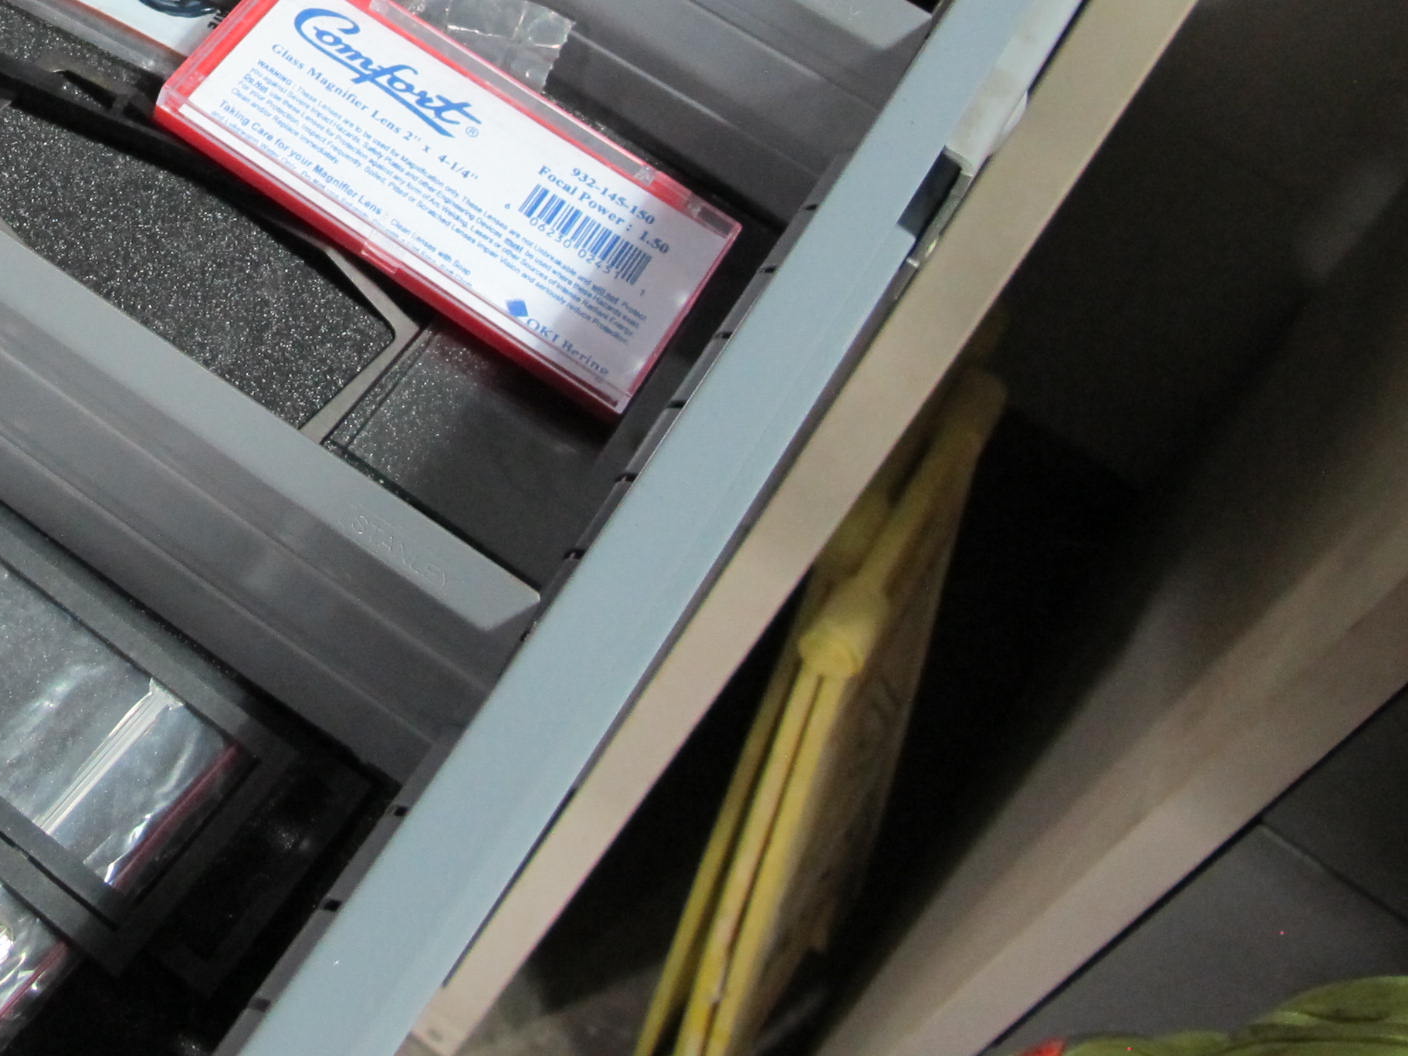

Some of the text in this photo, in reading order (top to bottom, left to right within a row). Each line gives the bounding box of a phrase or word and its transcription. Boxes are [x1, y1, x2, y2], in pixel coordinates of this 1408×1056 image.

[270, 43, 306, 69] Glass
[306, 66, 369, 111] Magnifier
[370, 109, 402, 134] Lens
[294, 7, 482, 138] Comfort
[219, 100, 251, 126] Taking
[250, 122, 274, 141] Care
[274, 138, 290, 151] for
[287, 149, 313, 168] your
[312, 164, 358, 199] Magnifier
[358, 195, 383, 215] Lens
[571, 167, 657, 226] 932-145-150
[528, 217, 573, 249] 06230
[537, 165, 671, 254] Focal Power 1.50
[526, 318, 561, 343] OKI
